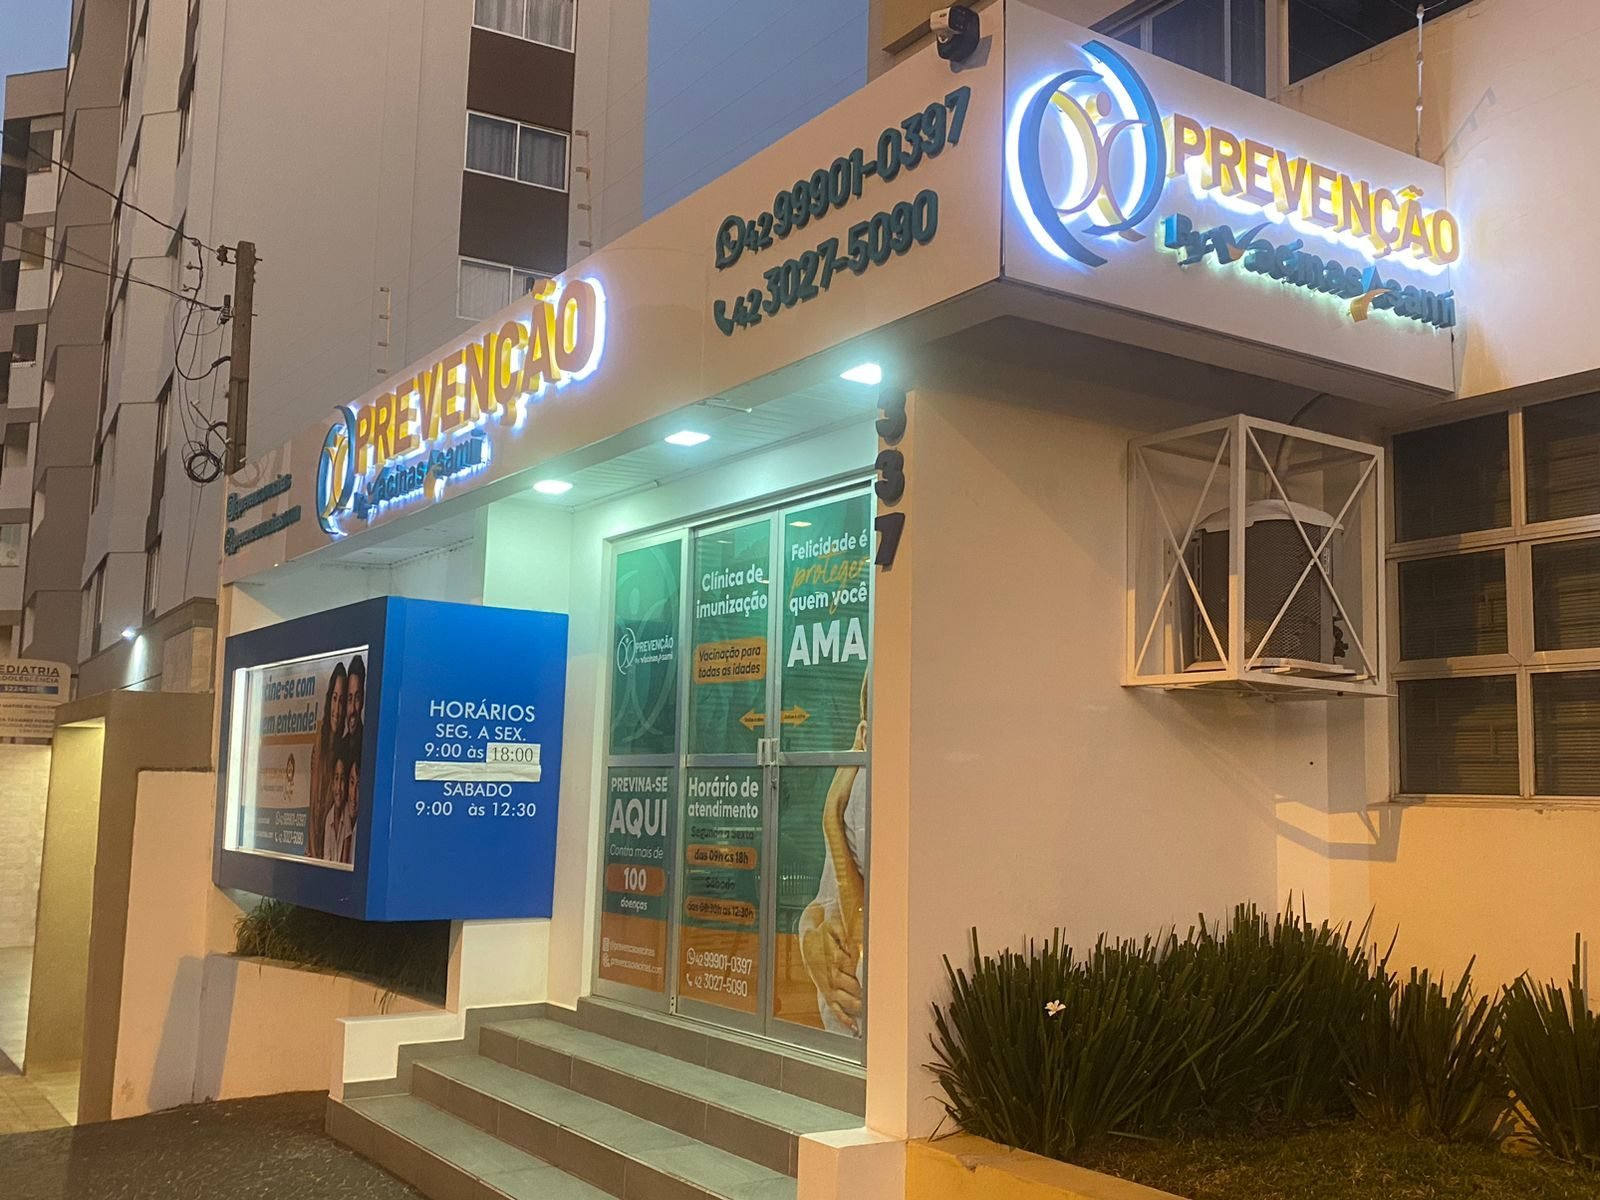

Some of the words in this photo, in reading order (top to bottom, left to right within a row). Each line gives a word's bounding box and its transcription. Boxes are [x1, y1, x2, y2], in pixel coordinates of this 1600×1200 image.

[744, 212, 773, 253] 42
[773, 86, 971, 240] 99901-0397
[1163, 113, 1459, 265] PREVENÇÃO
[733, 289, 762, 330] 42
[762, 189, 938, 316] 3027-5090
[354, 278, 597, 475] PREVENÇÃO
[791, 532, 856, 561] Felicidade
[859, 528, 868, 547] é
[702, 567, 744, 592] Clínica
[747, 564, 763, 581] de
[696, 590, 768, 619] imunização
[789, 591, 828, 616] quem
[831, 581, 868, 606] você
[699, 647, 740, 662] Vacinação
[741, 646, 761, 661] para
[787, 617, 867, 668] AMA
[698, 666, 720, 679] todas
[722, 667, 731, 676] as
[732, 662, 760, 675] idades
[295, 676, 316, 698] com
[276, 702, 319, 733] entende!
[430, 698, 535, 723] HORÁRIOS
[435, 723, 472, 739] SEG.
[477, 726, 490, 740] A
[495, 726, 527, 741] SEX.
[424, 743, 462, 758] 9:00
[467, 745, 484, 759] às
[492, 746, 534, 763] 18:00
[443, 782, 512, 798] SABADO
[611, 776, 668, 793] PREVINA-SE
[688, 775, 737, 798] Horário
[741, 776, 759, 798] de
[415, 801, 453, 816] 9:00
[468, 803, 485, 816] às
[492, 802, 536, 817] 12:30
[609, 798, 668, 839] AQUI
[688, 800, 759, 819] atendimento
[610, 844, 634, 857] Contra
[634, 847, 653, 859] mais
[653, 847, 664, 859] de
[735, 851, 748, 864] 18h
[623, 867, 647, 892] 100
[620, 897, 648, 913] doenças
[703, 951, 752, 976] 99901-0397
[703, 972, 748, 997] 3027-5090
